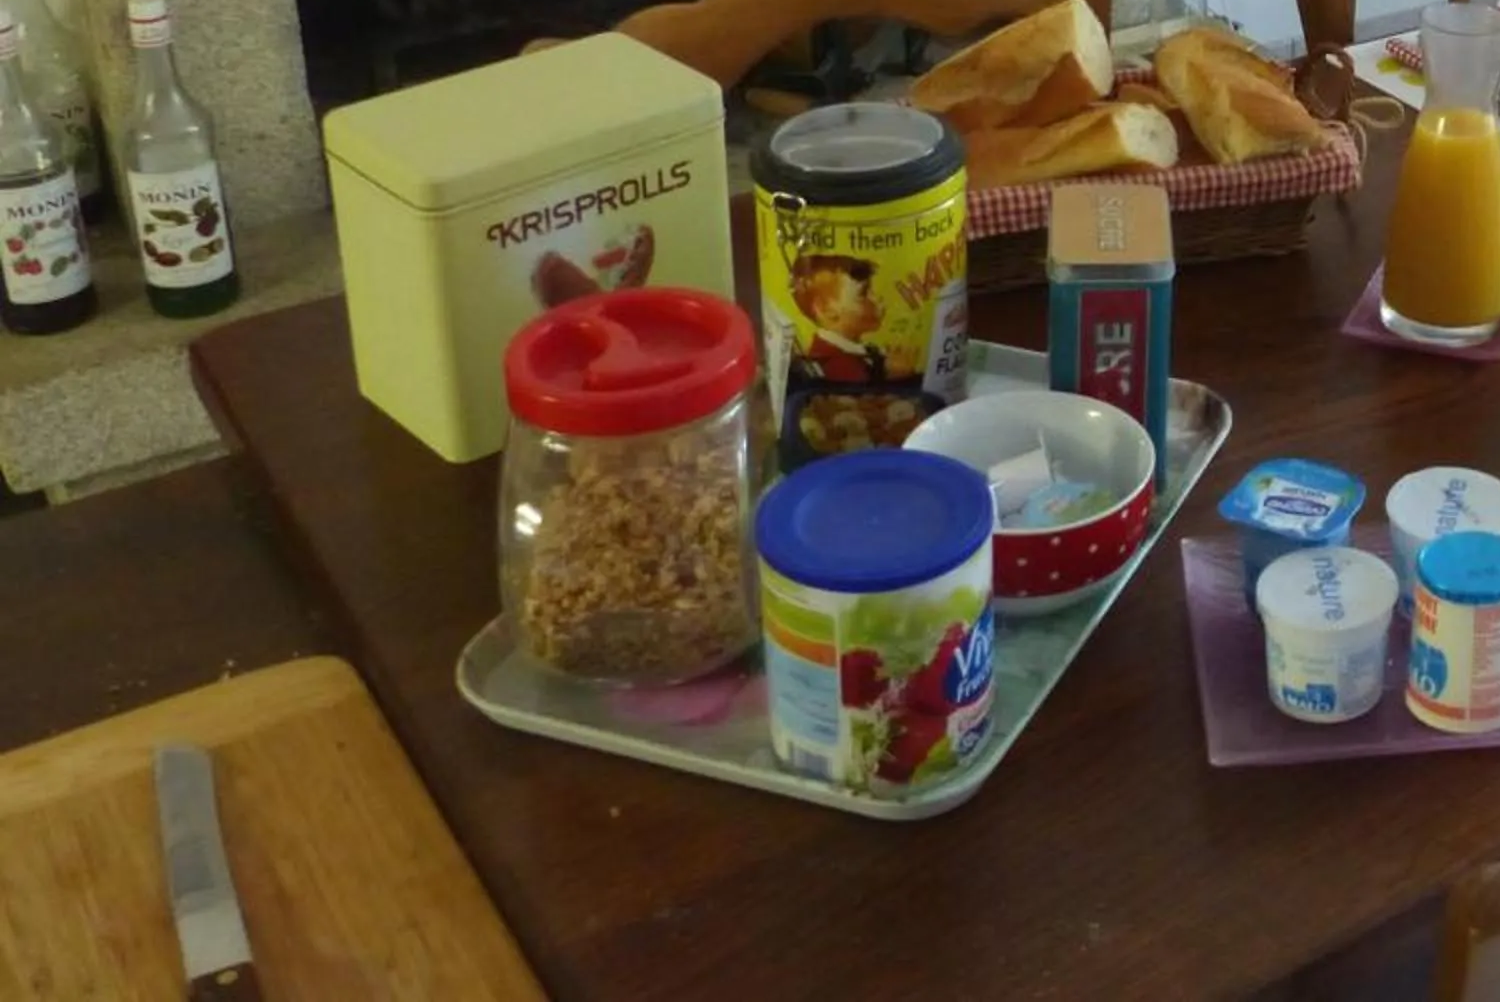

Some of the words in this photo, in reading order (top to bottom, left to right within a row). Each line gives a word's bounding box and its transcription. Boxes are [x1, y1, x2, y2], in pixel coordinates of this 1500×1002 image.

[7, 190, 77, 220] MONIN
[137, 184, 212, 204] MONIN
[486, 160, 692, 249] KRISPROLLS
[850, 225, 904, 250] them
[914, 209, 956, 243] back
[1312, 556, 1345, 622] nature
